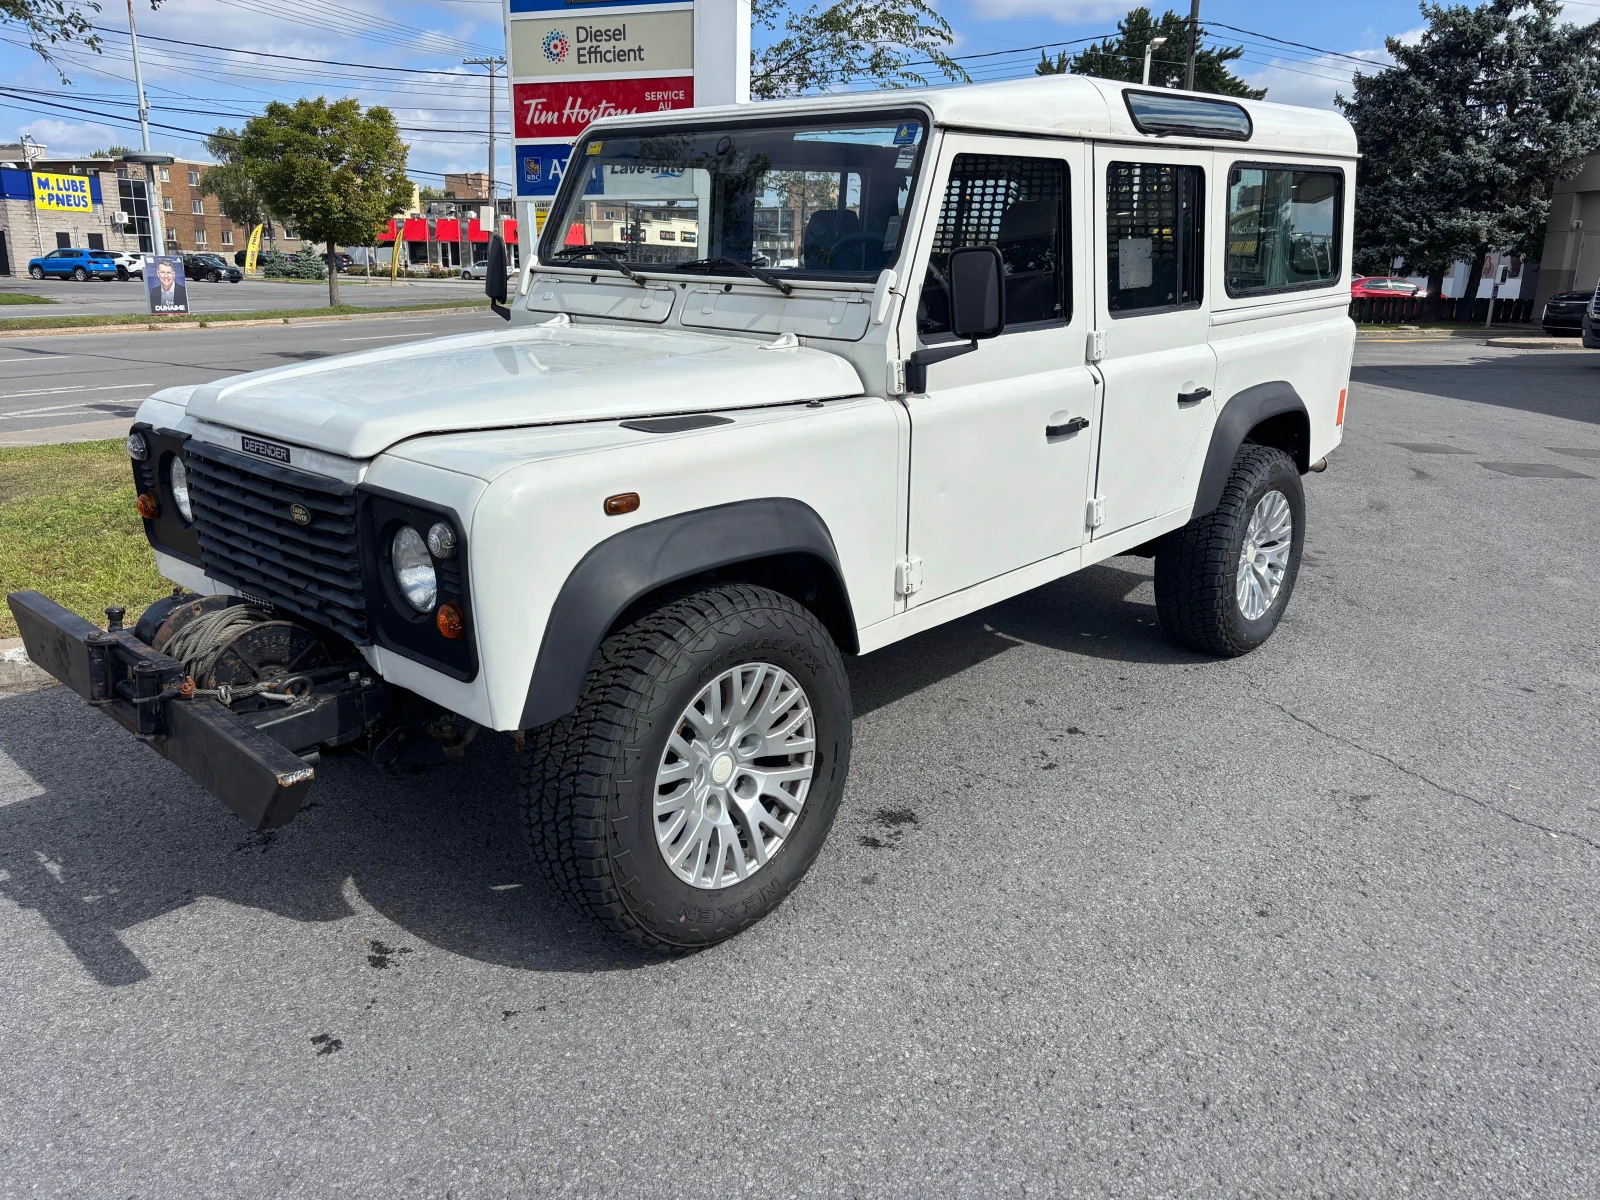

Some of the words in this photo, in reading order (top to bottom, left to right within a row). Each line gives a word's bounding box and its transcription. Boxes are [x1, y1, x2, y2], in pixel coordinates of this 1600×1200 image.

[576, 23, 626, 43] Diesel
[577, 45, 645, 64] Efficient
[645, 90, 685, 101] SERVICE
[523, 98, 559, 126] Tim
[658, 101, 672, 111] AU
[155, 304, 186, 312] DUHAIME
[244, 439, 288, 461] DEFENDER
